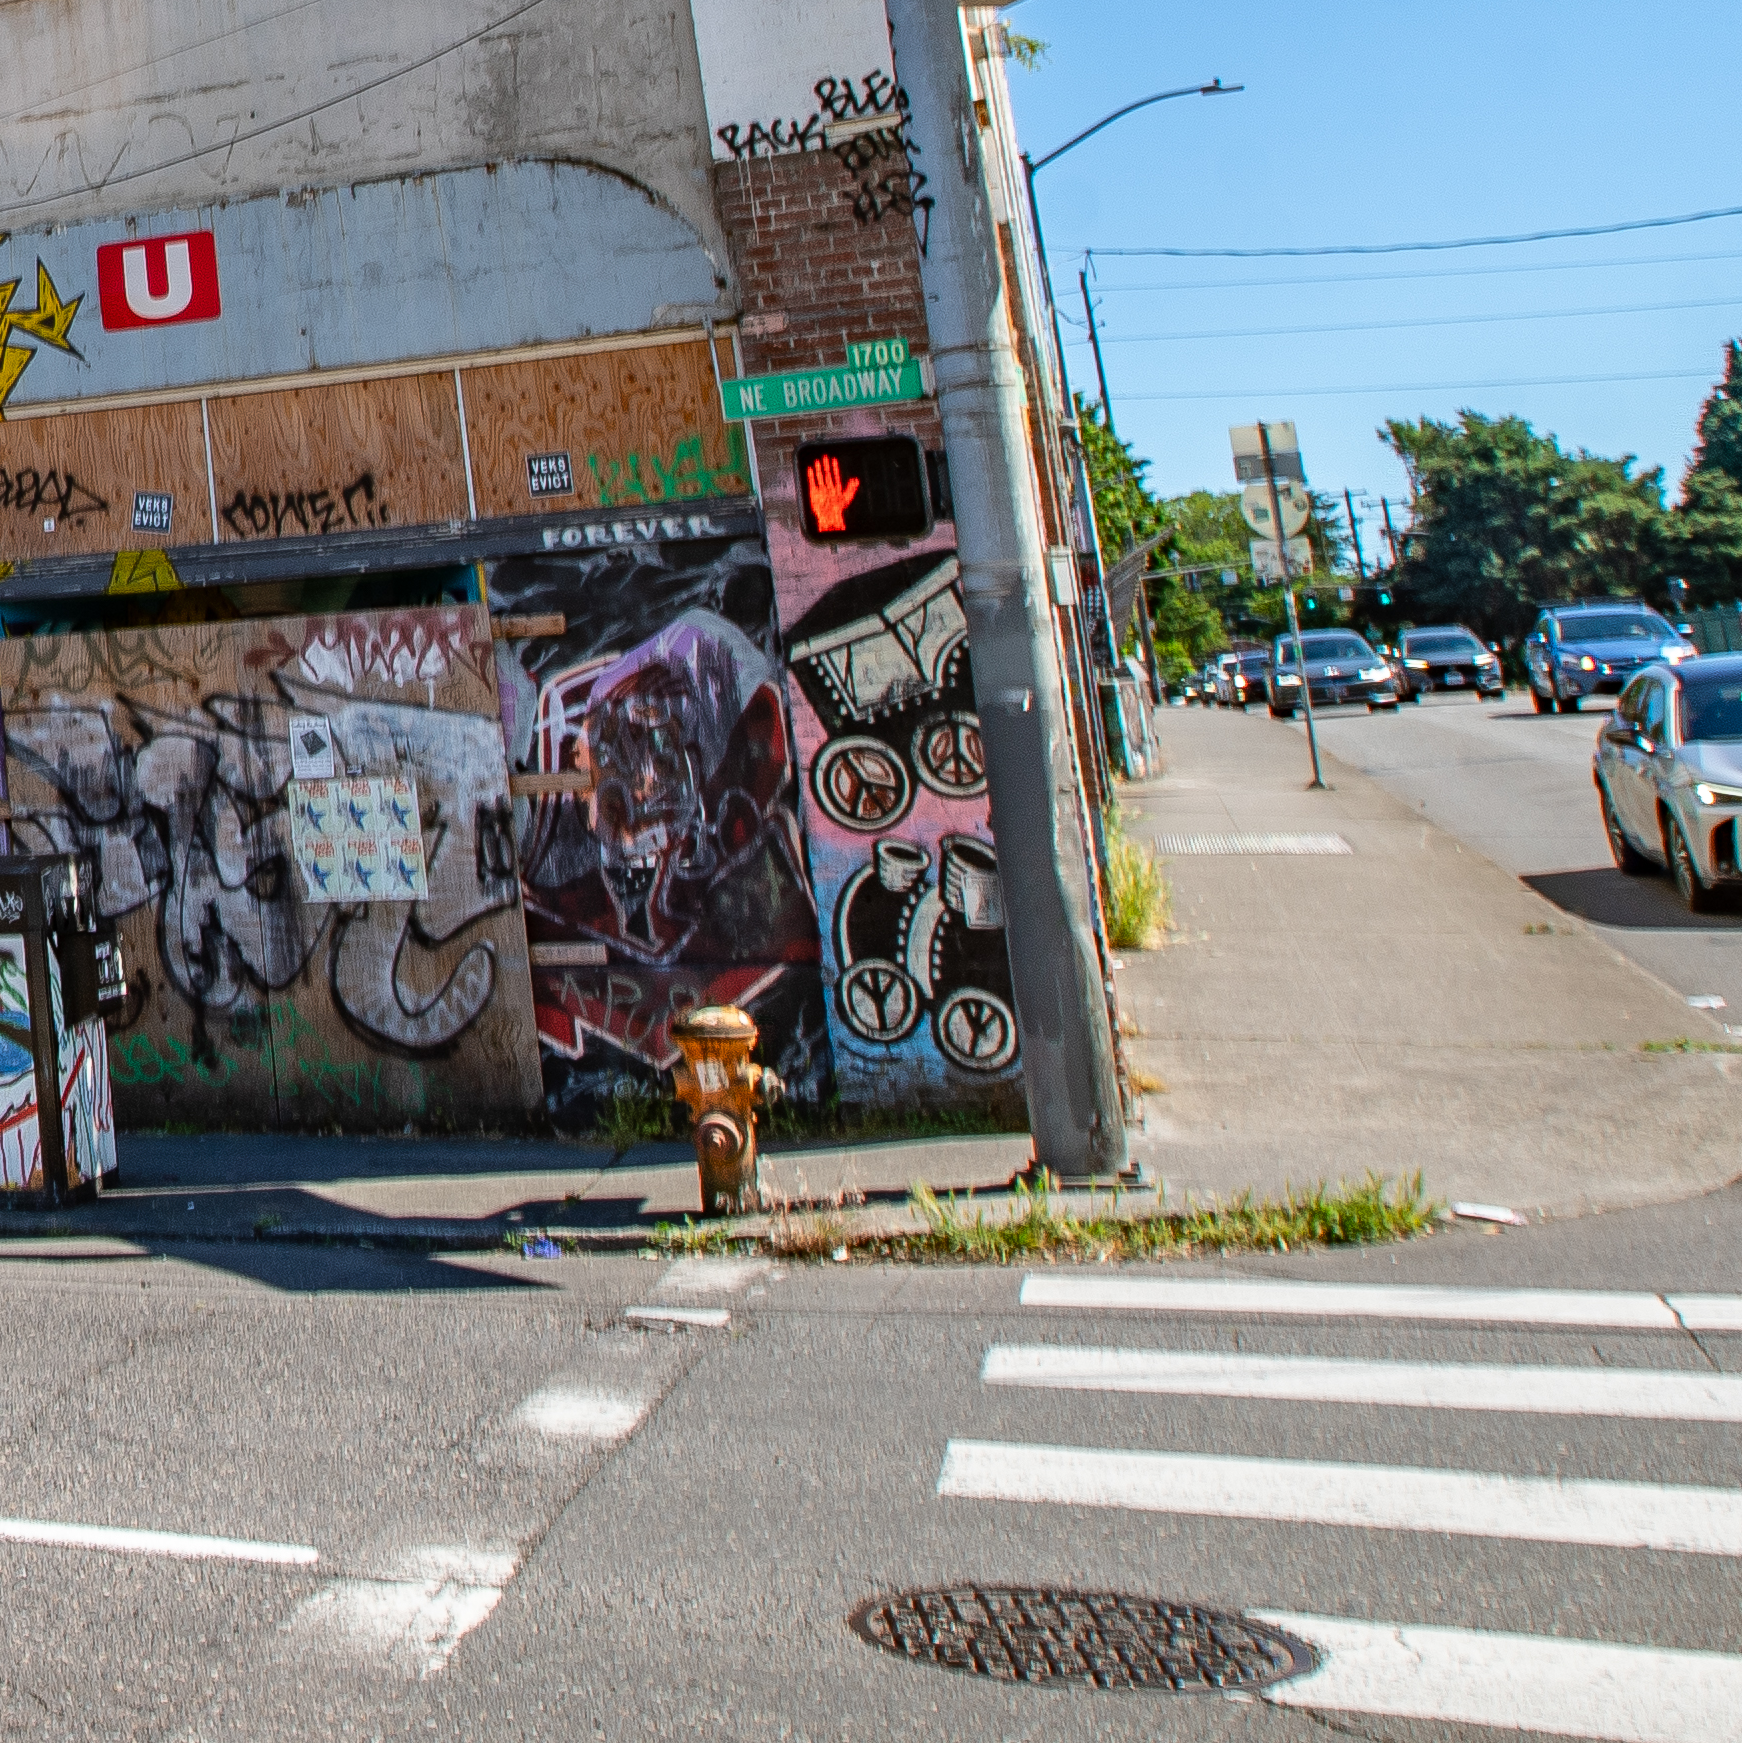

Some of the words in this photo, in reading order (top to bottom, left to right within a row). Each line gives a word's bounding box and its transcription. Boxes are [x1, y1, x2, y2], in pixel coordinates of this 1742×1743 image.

[121, 242, 194, 321] U
[853, 342, 904, 368] 1700
[739, 383, 767, 413] NE
[783, 367, 903, 409] BROADWAY
[543, 515, 727, 550] FOREVER
